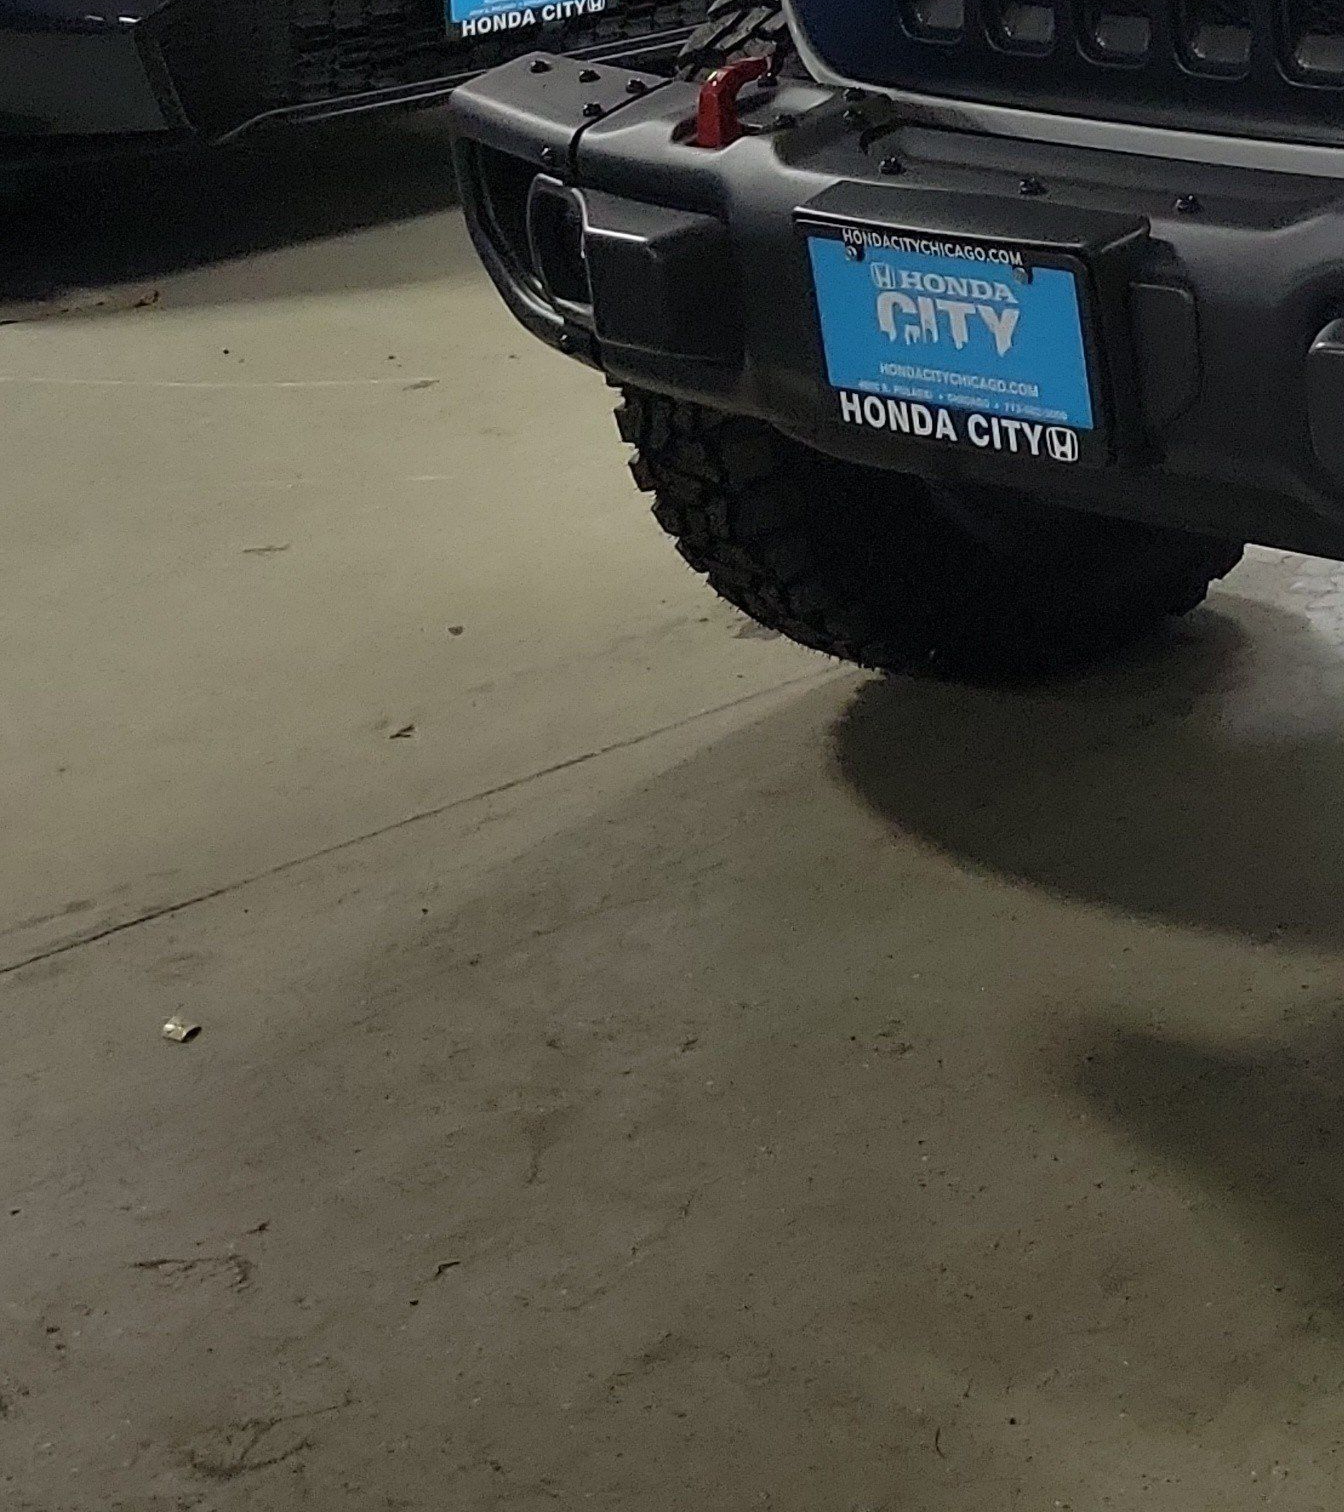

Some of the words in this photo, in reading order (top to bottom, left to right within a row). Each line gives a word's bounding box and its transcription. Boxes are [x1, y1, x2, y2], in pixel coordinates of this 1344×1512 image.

[461, 9, 536, 37] HONDA
[842, 227, 1024, 267] HONDACITYCHICAGO.COM
[900, 270, 1020, 304] HONDA
[877, 291, 1020, 358] CITY
[839, 391, 959, 442] HONDA
[966, 413, 1044, 456] CITY
